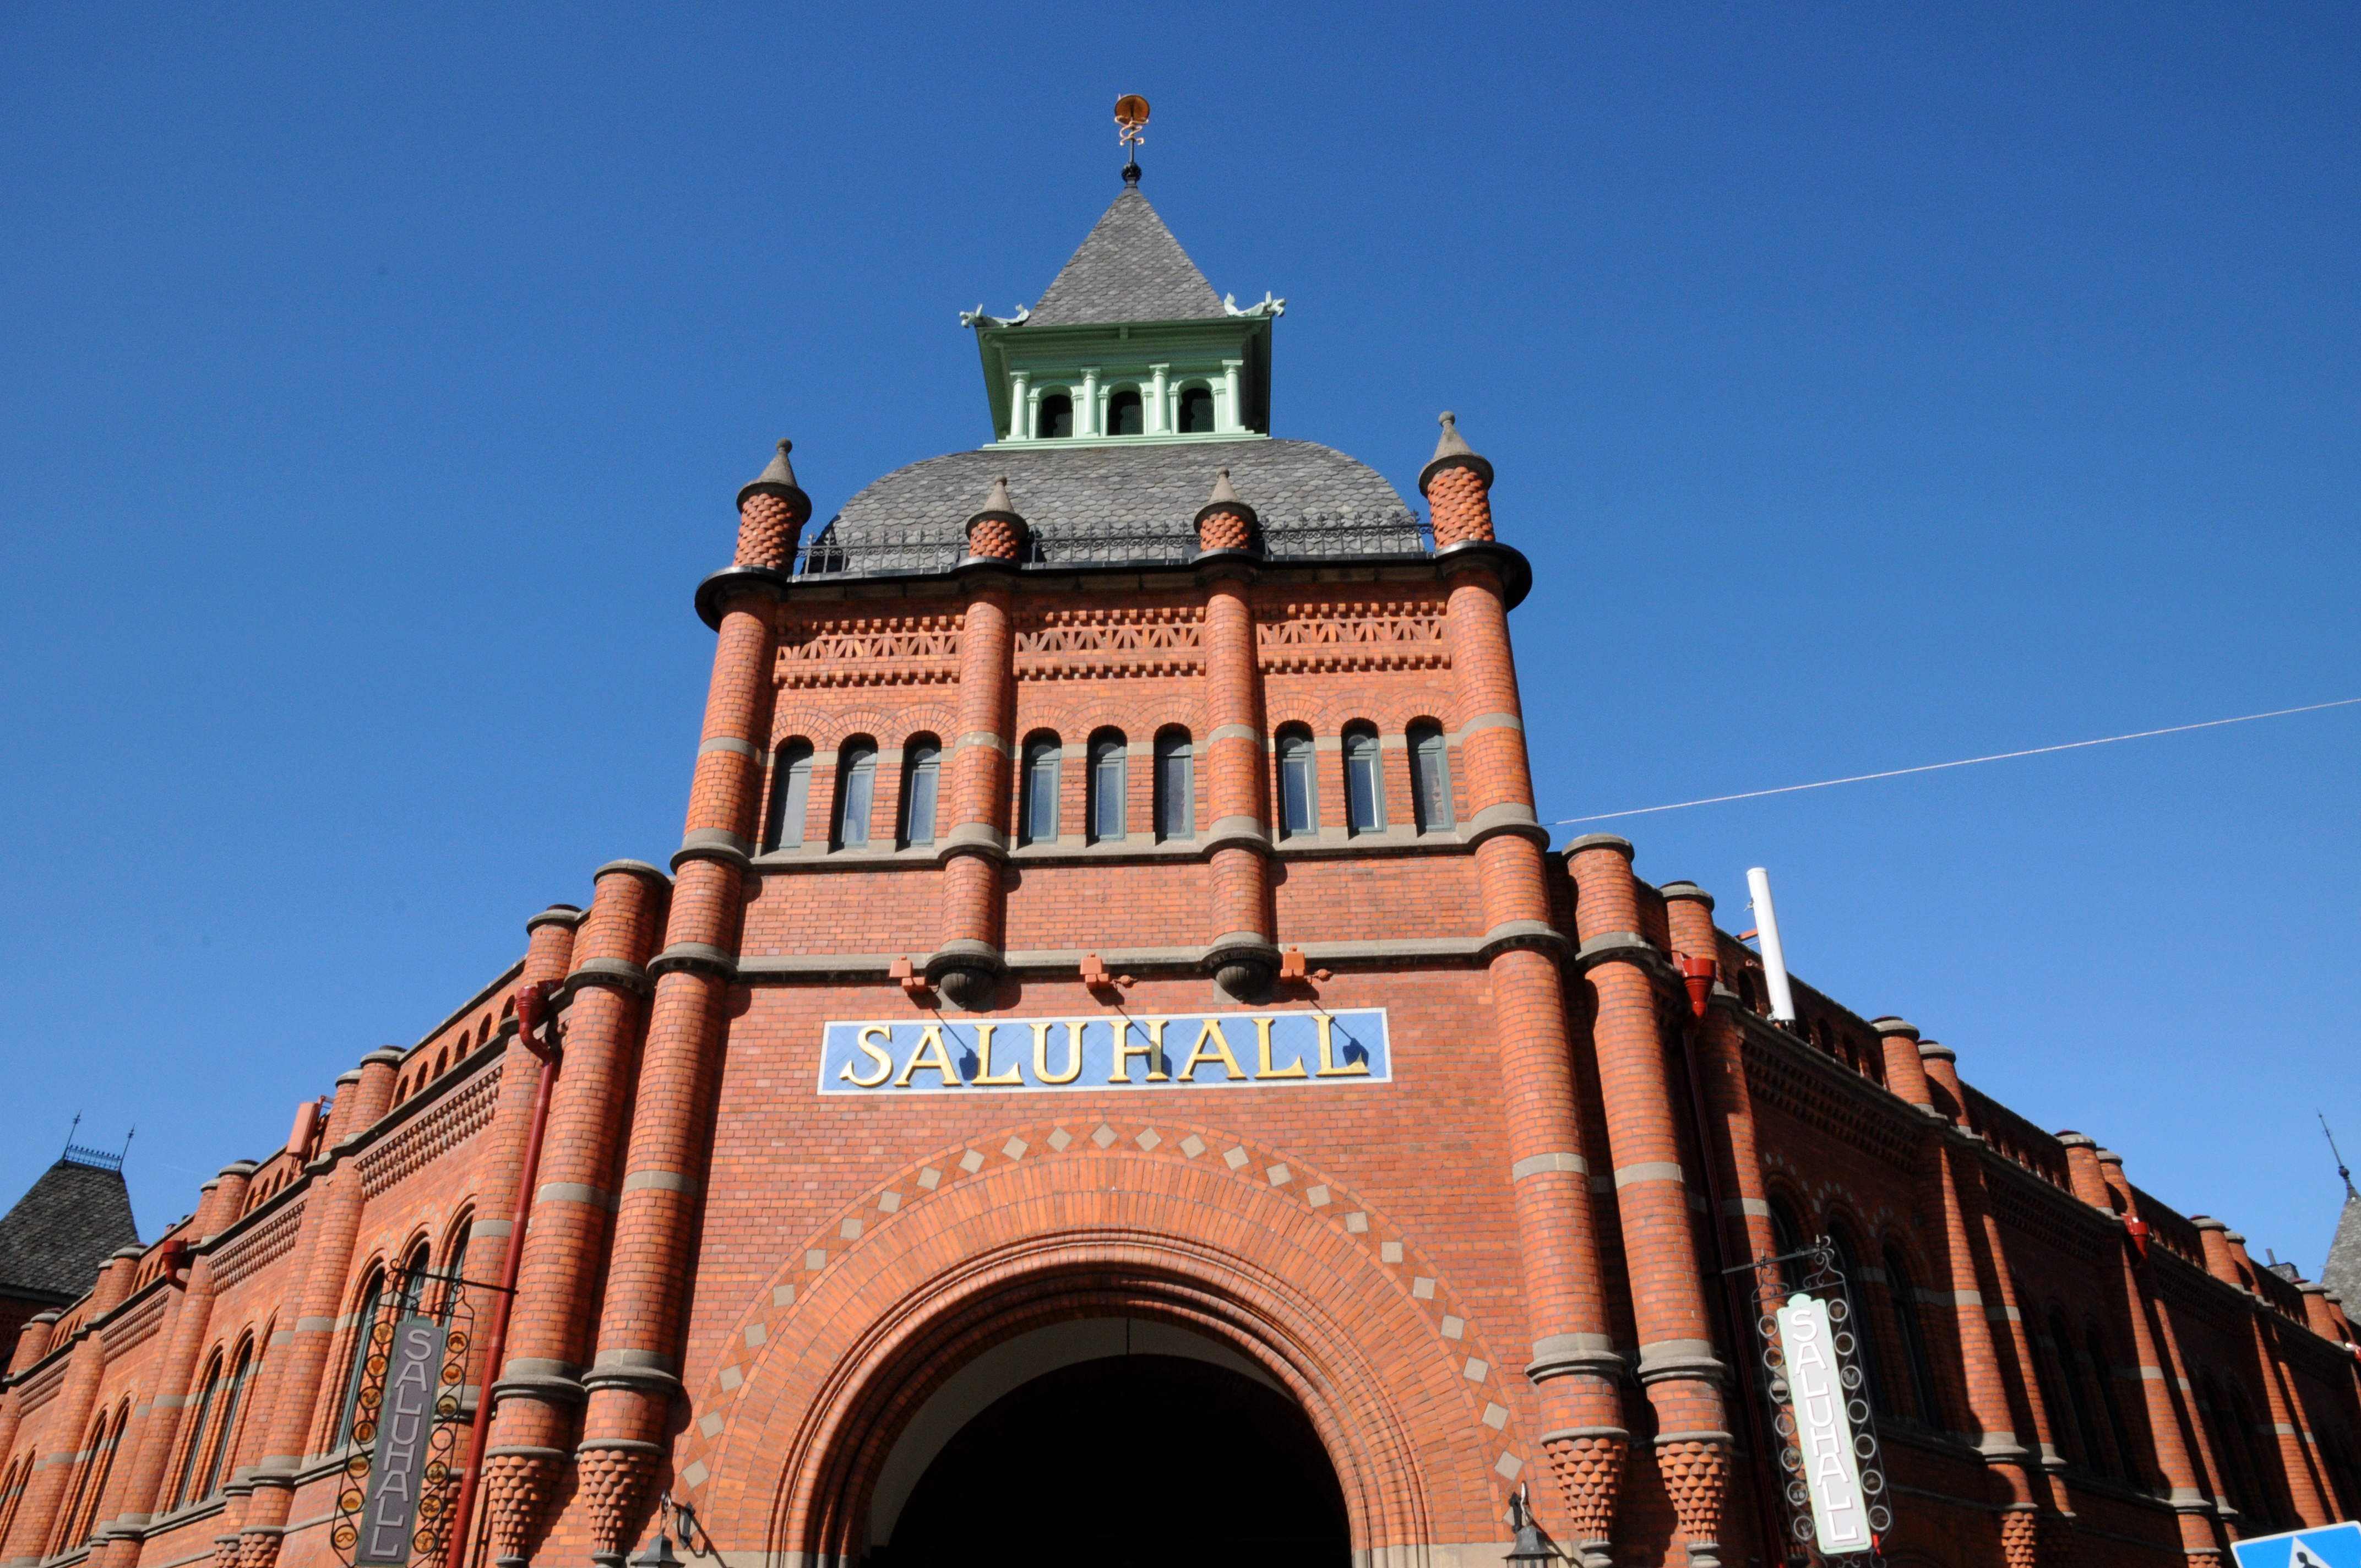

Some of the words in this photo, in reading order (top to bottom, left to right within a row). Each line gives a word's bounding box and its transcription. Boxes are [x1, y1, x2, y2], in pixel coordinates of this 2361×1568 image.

[839, 1014, 1370, 1088] SALUHALL
[370, 1329, 432, 1558] SALUHALL
[1790, 1309, 1858, 1542] SALUHALL
